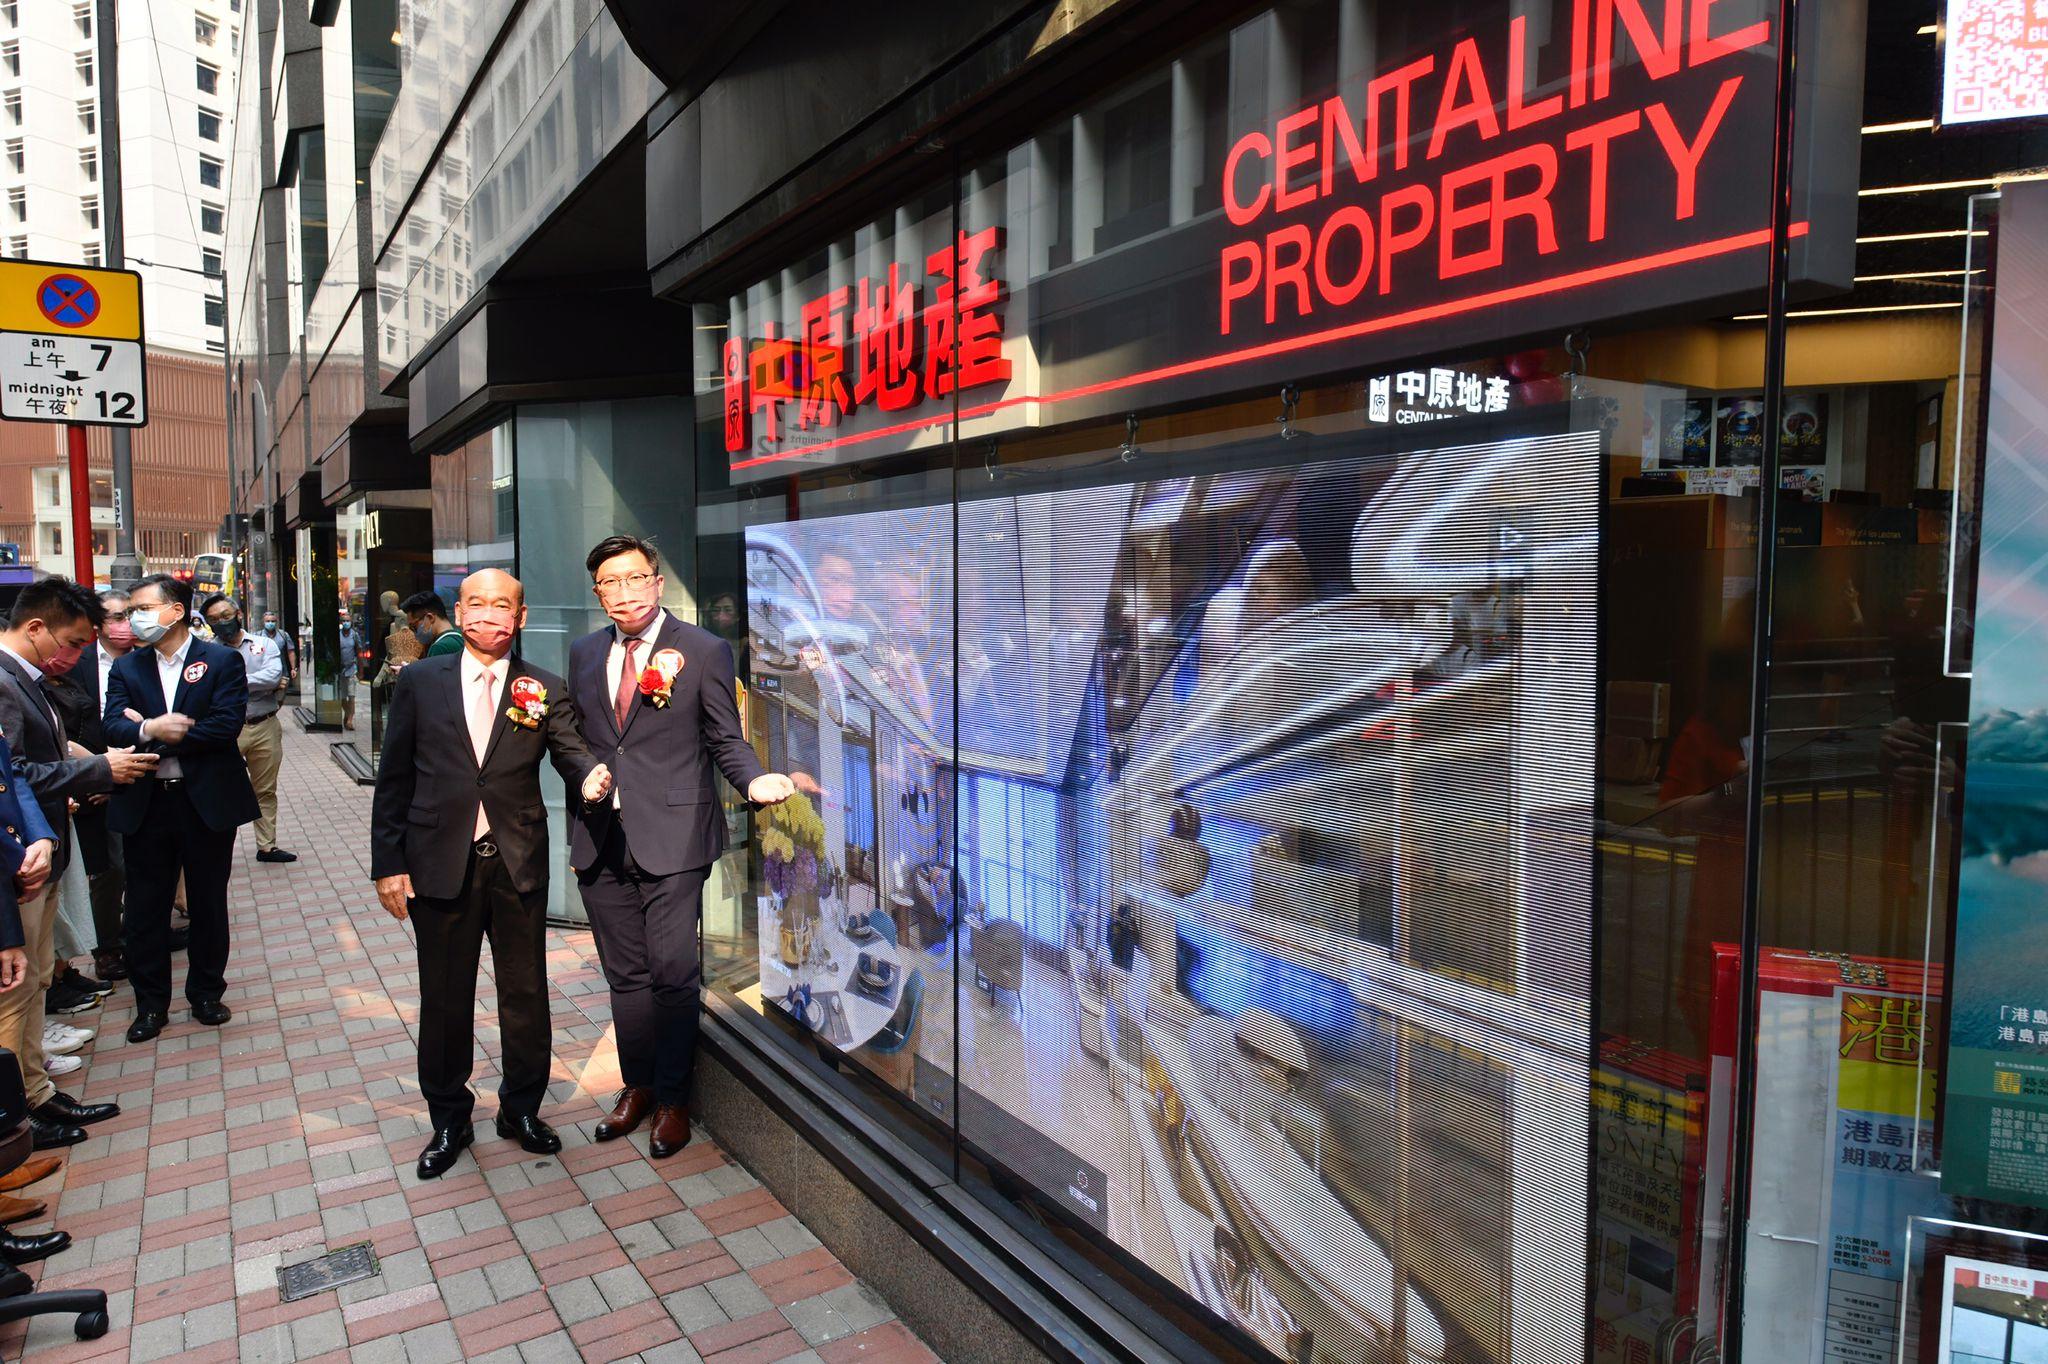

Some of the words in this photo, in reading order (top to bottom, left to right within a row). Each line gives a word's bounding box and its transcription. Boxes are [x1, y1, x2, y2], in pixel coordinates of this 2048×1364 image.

[1220, 75, 1744, 335] PROPERTY
[31, 338, 56, 349] am
[748, 226, 1012, 442] 中原地產
[23, 351, 66, 369] 上午
[90, 343, 112, 372] 7
[9, 383, 84, 397] midnight
[95, 390, 136, 419] 12
[1396, 368, 1510, 413] 中原地產
[26, 397, 68, 416] 午夜
[1839, 994, 1933, 1067] 港
